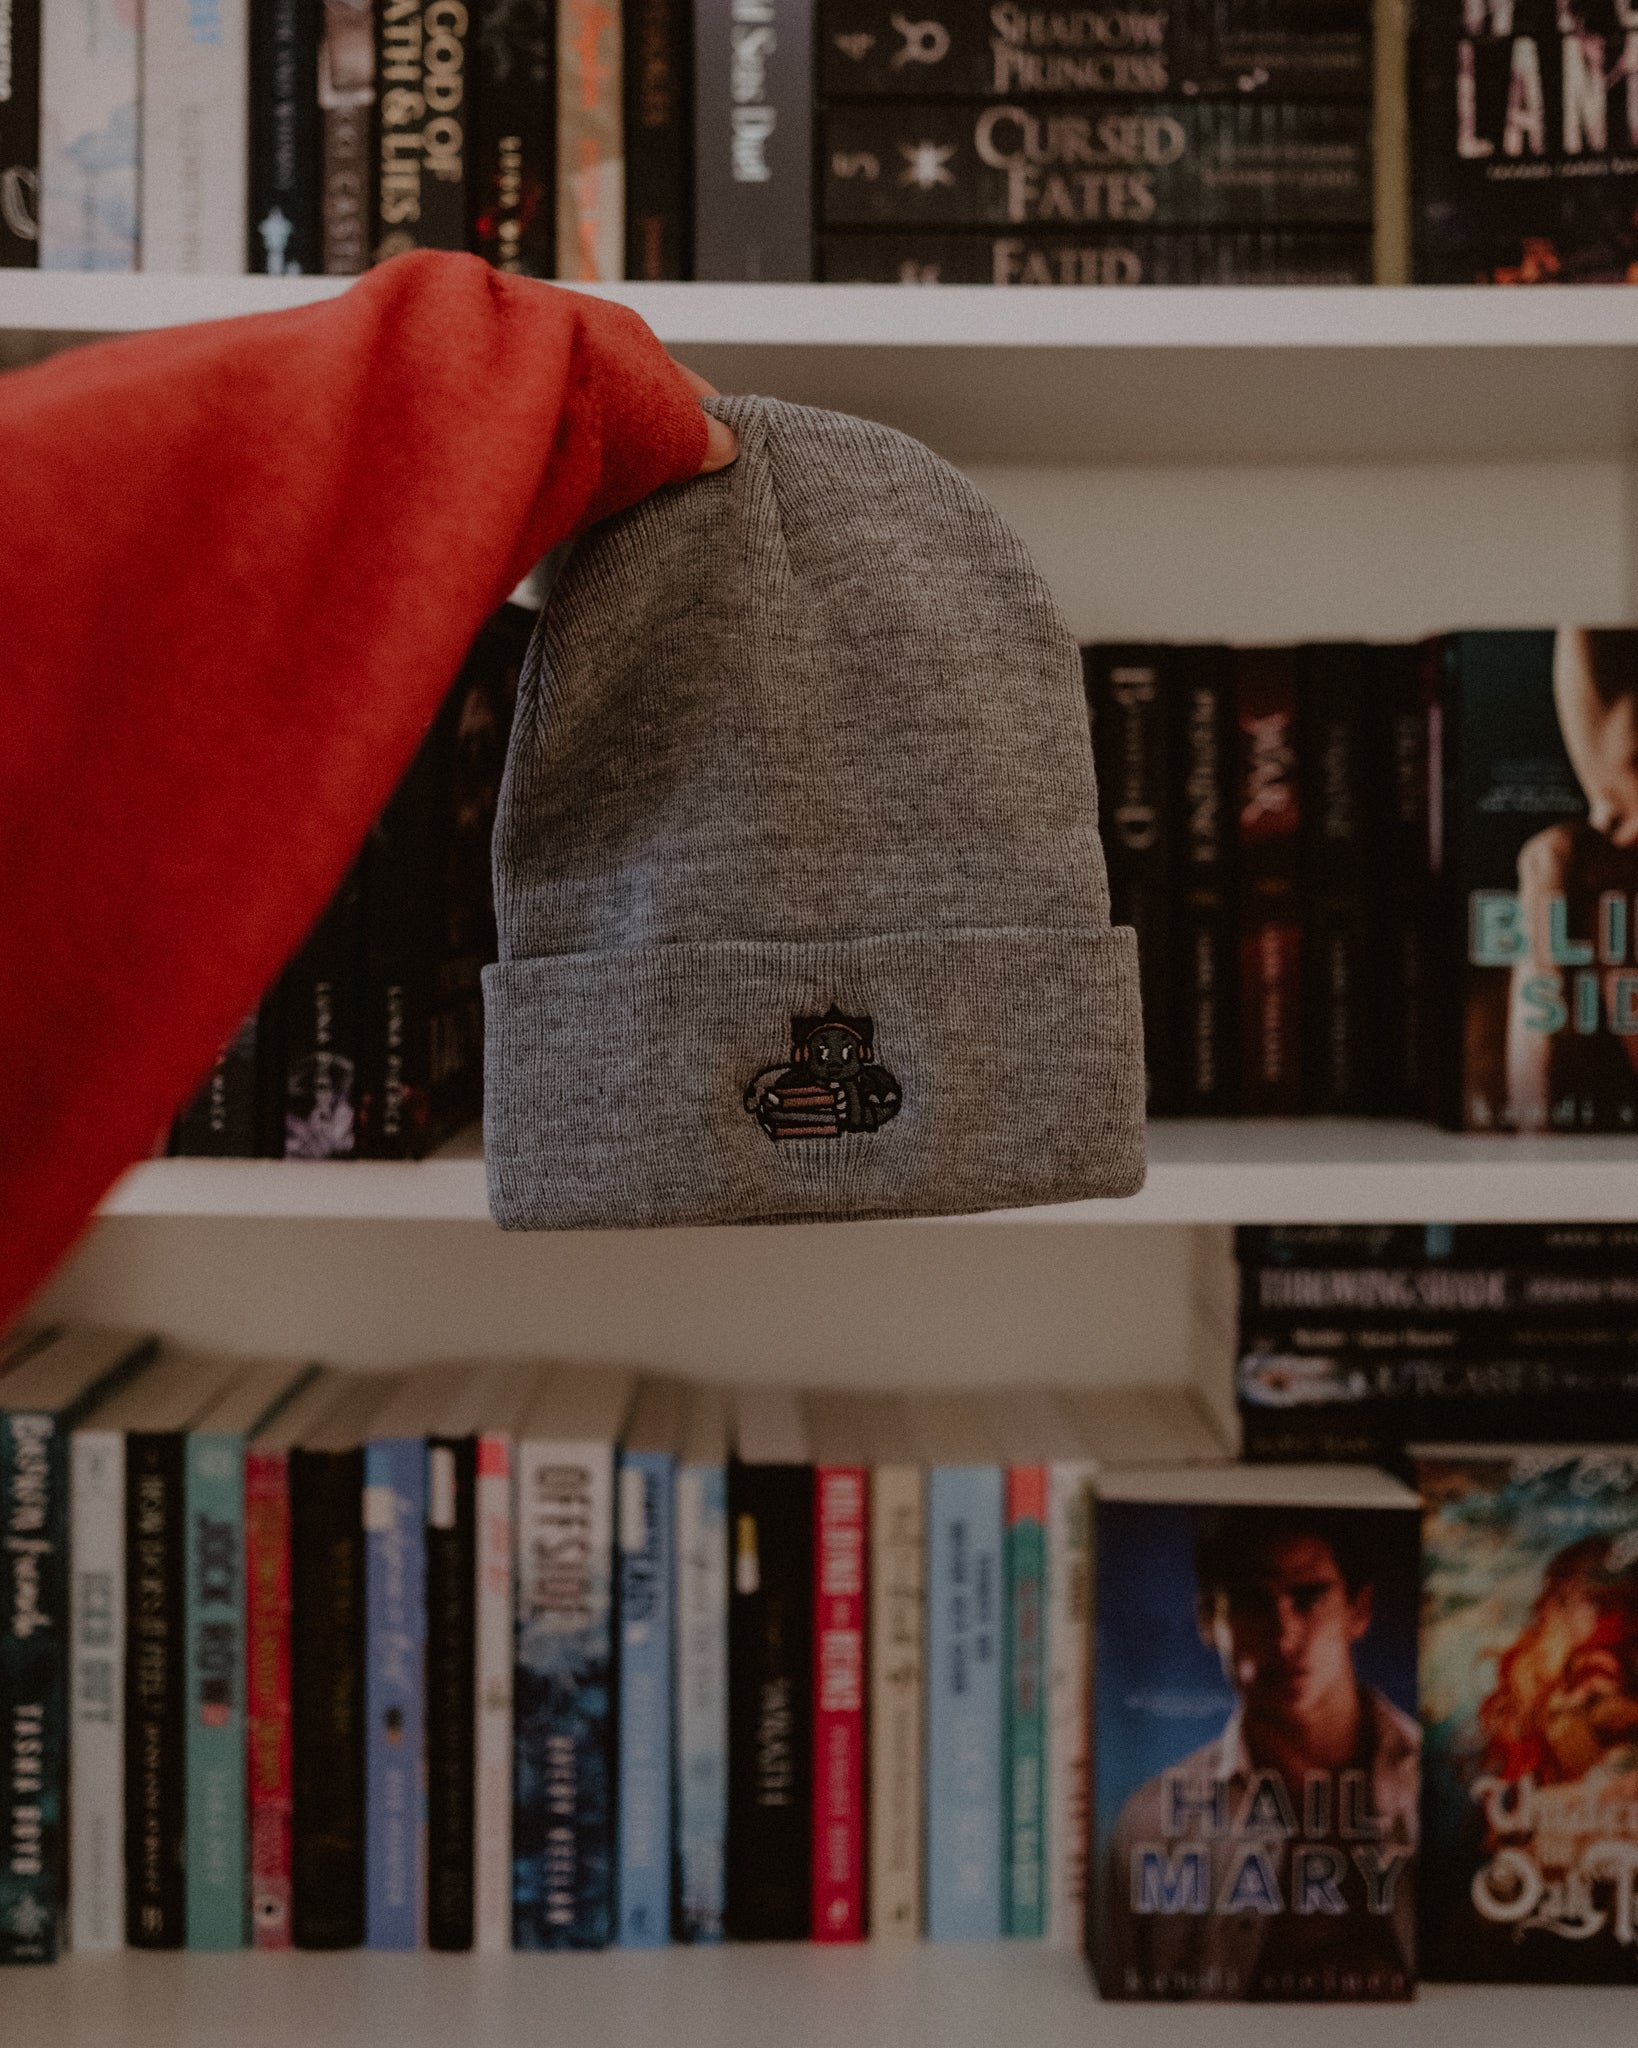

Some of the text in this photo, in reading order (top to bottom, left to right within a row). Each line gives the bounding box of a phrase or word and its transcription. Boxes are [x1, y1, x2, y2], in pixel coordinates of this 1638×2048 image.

[423, 1, 469, 111] GOD
[1468, 888, 1638, 967] BLI
[532, 1465, 594, 1628] OFFSIDE
[1158, 1768, 1394, 1840] HAIL
[1129, 1840, 1417, 1916] MARY
